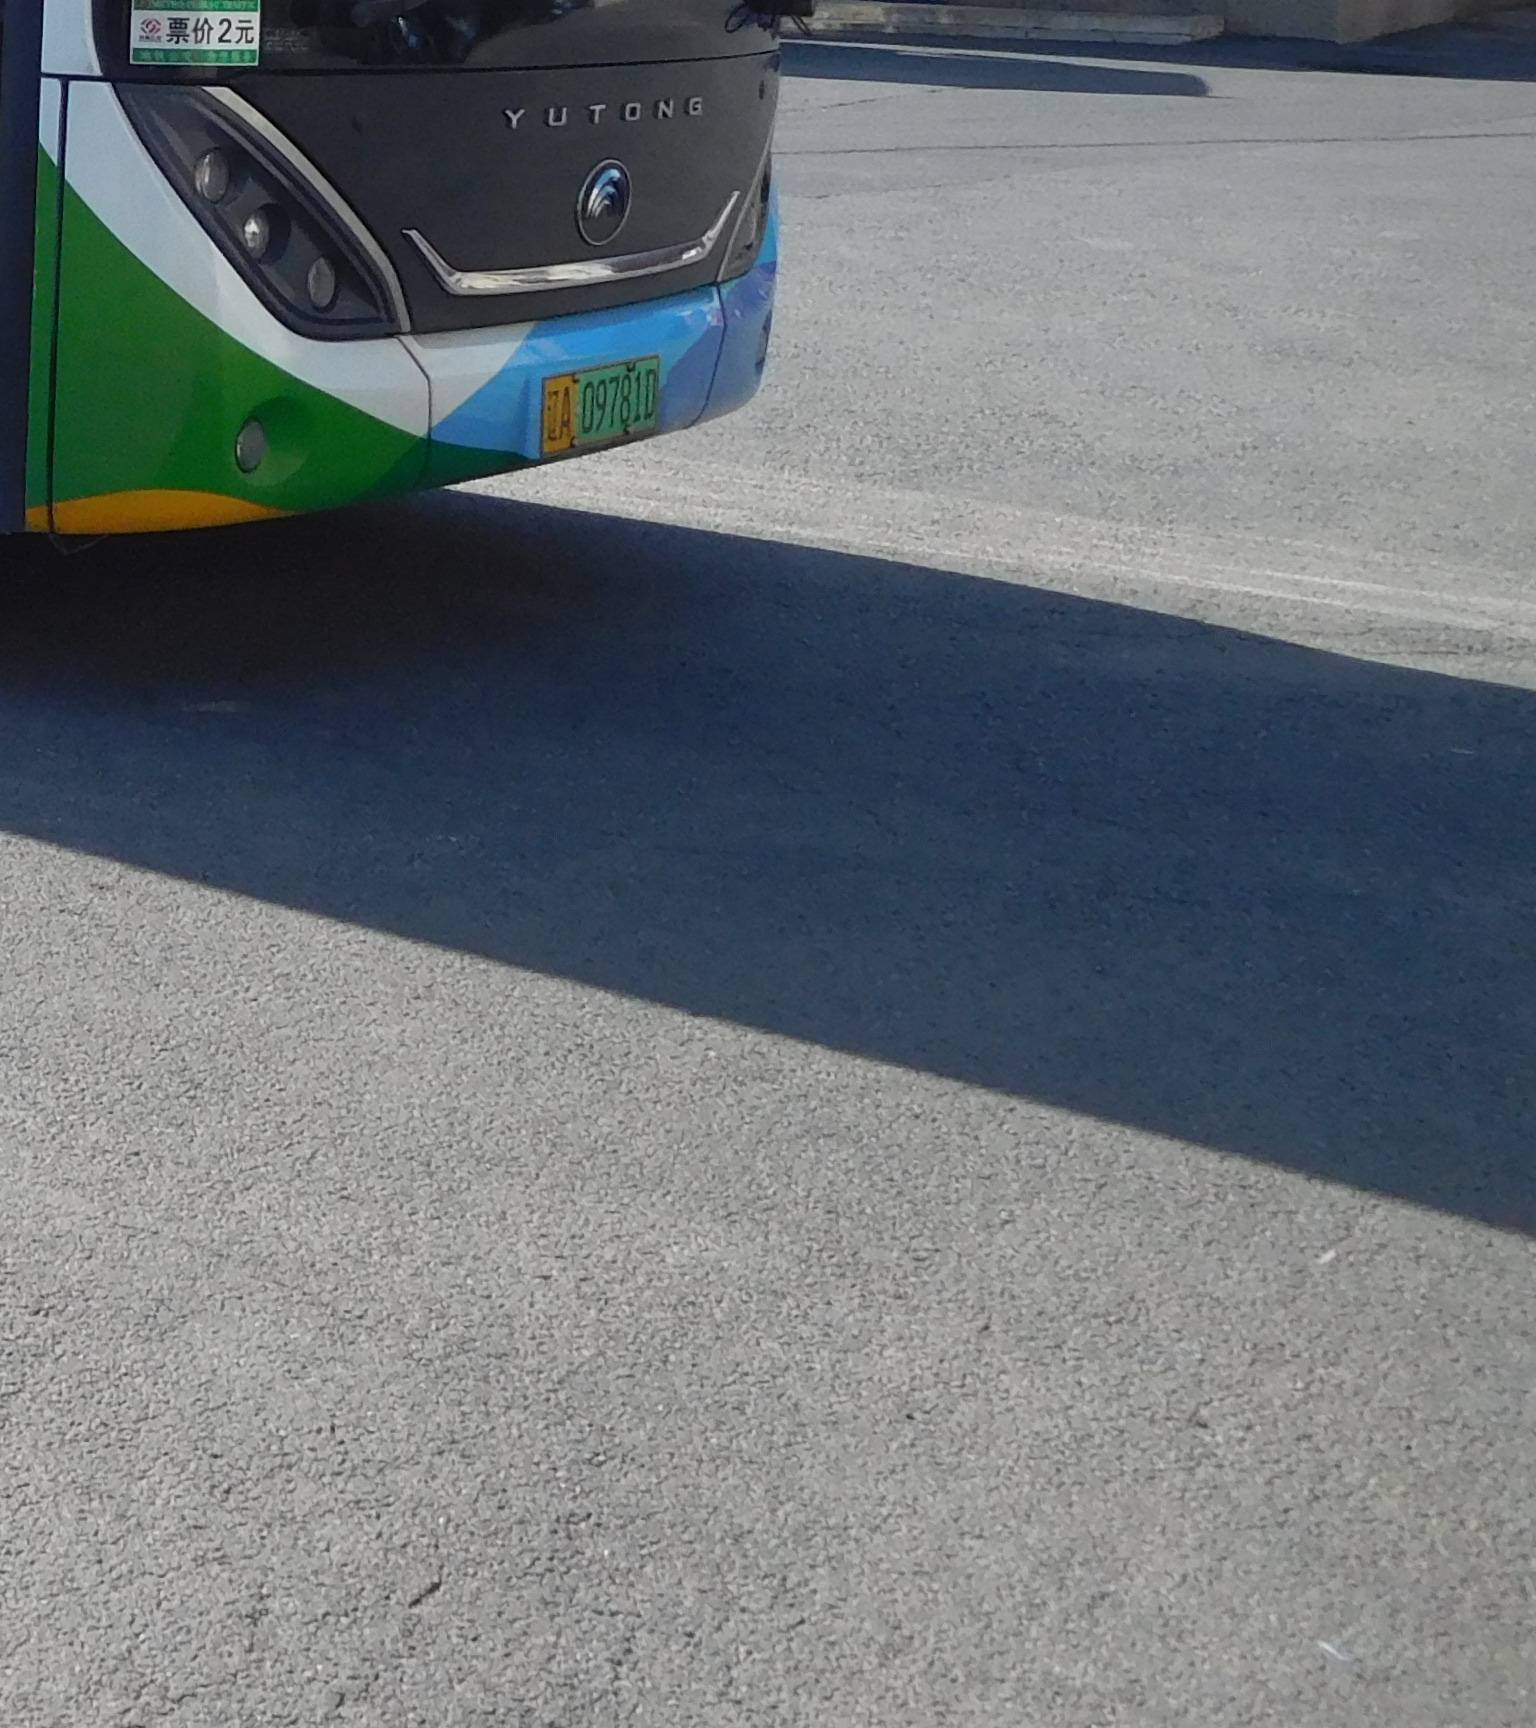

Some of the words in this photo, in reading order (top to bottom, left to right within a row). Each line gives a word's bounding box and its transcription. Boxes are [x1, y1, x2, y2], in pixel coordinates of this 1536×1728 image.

[166, 16, 255, 45] 票价2元
[505, 96, 703, 129] YUTONG
